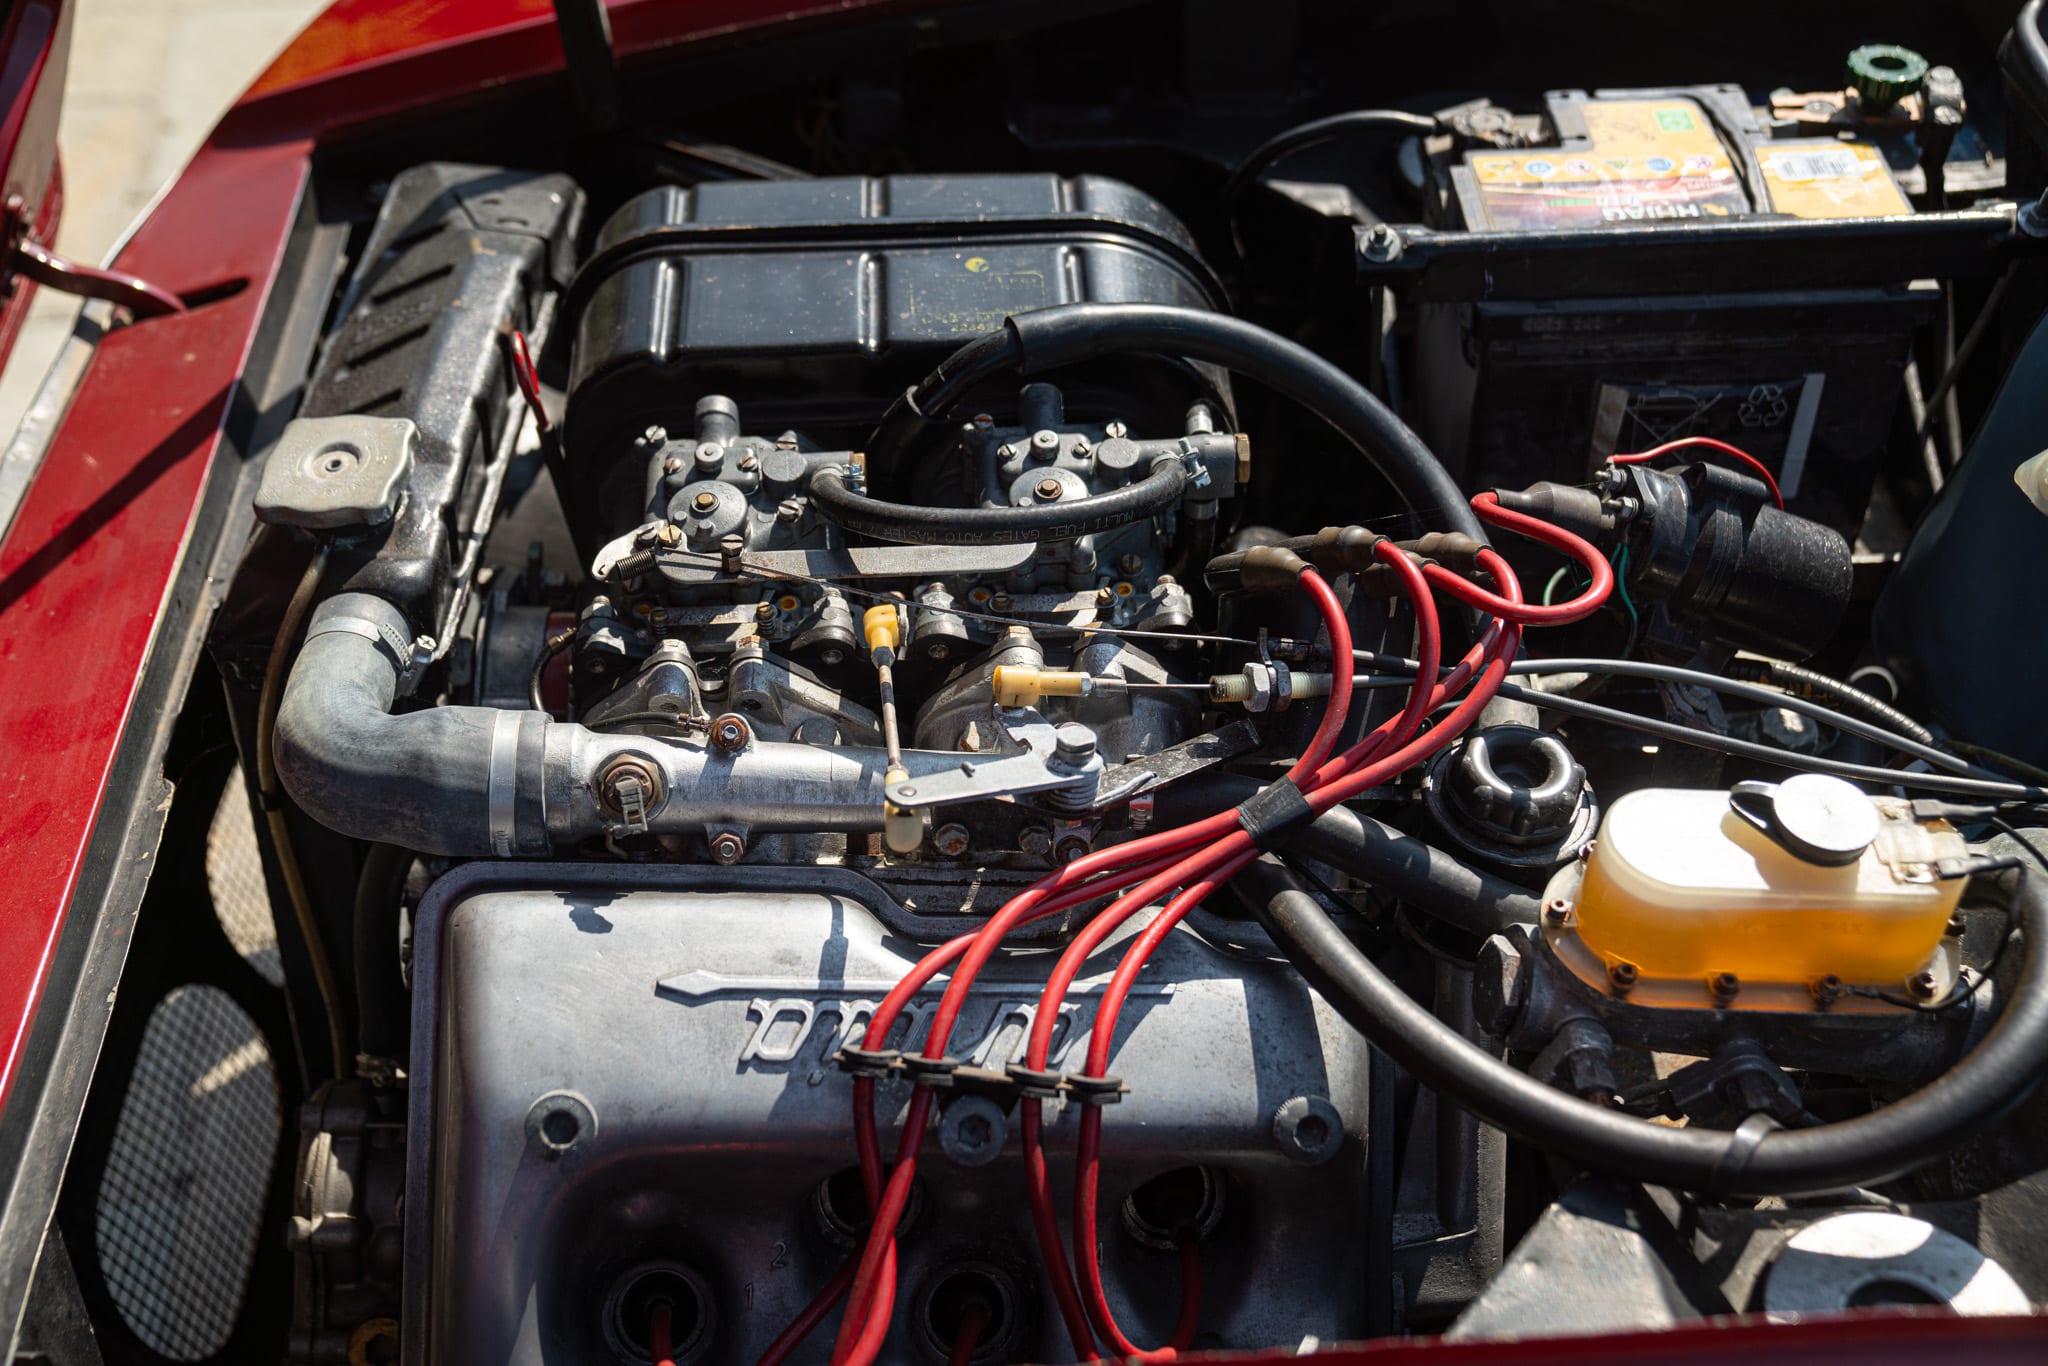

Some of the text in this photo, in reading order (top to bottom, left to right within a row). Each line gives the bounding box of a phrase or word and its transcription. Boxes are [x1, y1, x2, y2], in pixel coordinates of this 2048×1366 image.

[1095, 509, 1135, 530] MULTI
[882, 527, 937, 544] MASTER
[944, 532, 983, 544] AUTO
[992, 529, 1041, 543] GATES
[1047, 521, 1086, 538] FUEL
[769, 1240, 788, 1269] 2
[743, 1281, 754, 1311] 1
